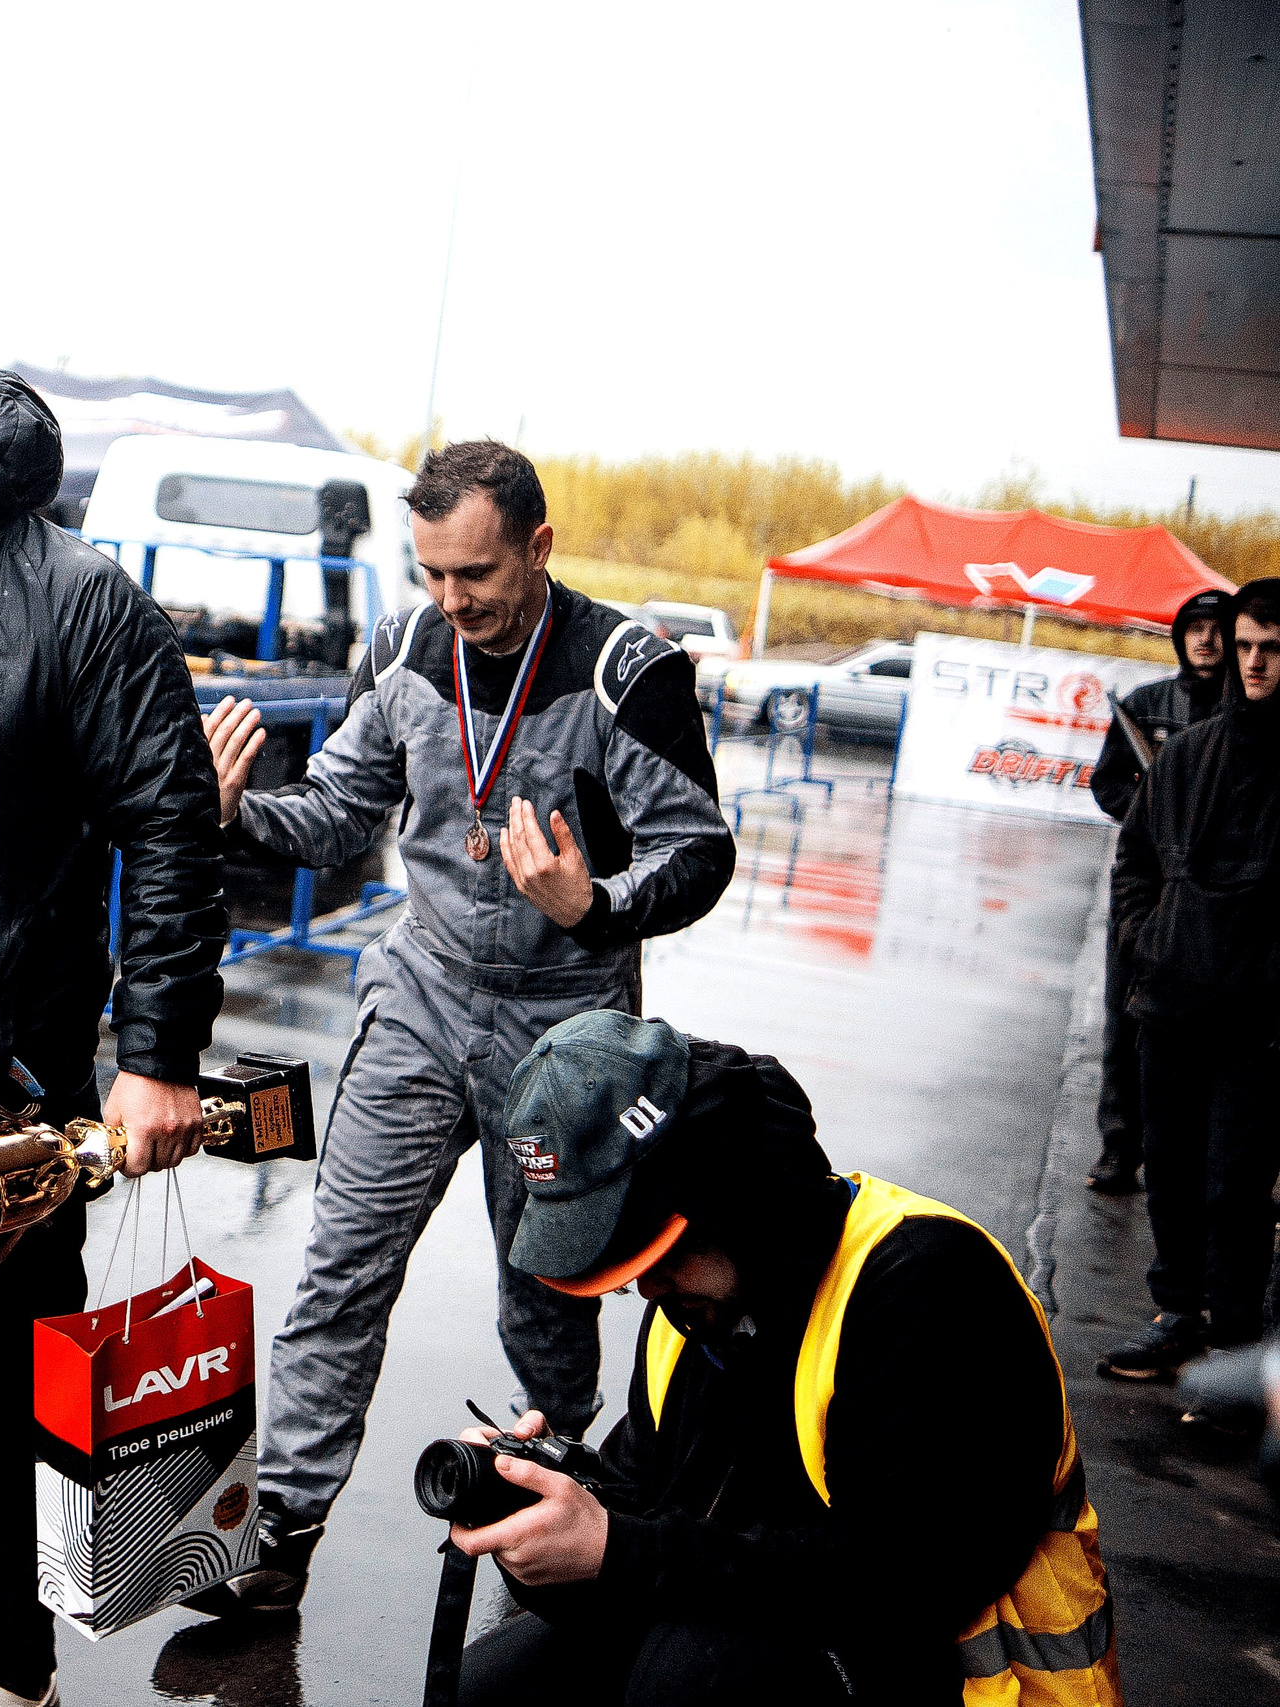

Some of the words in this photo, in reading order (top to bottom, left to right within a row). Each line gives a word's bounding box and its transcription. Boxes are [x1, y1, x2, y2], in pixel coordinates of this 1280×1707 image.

[620, 1095, 667, 1140] 01
[108, 1438, 150, 1461] Твое
[156, 1408, 234, 1449] решение
